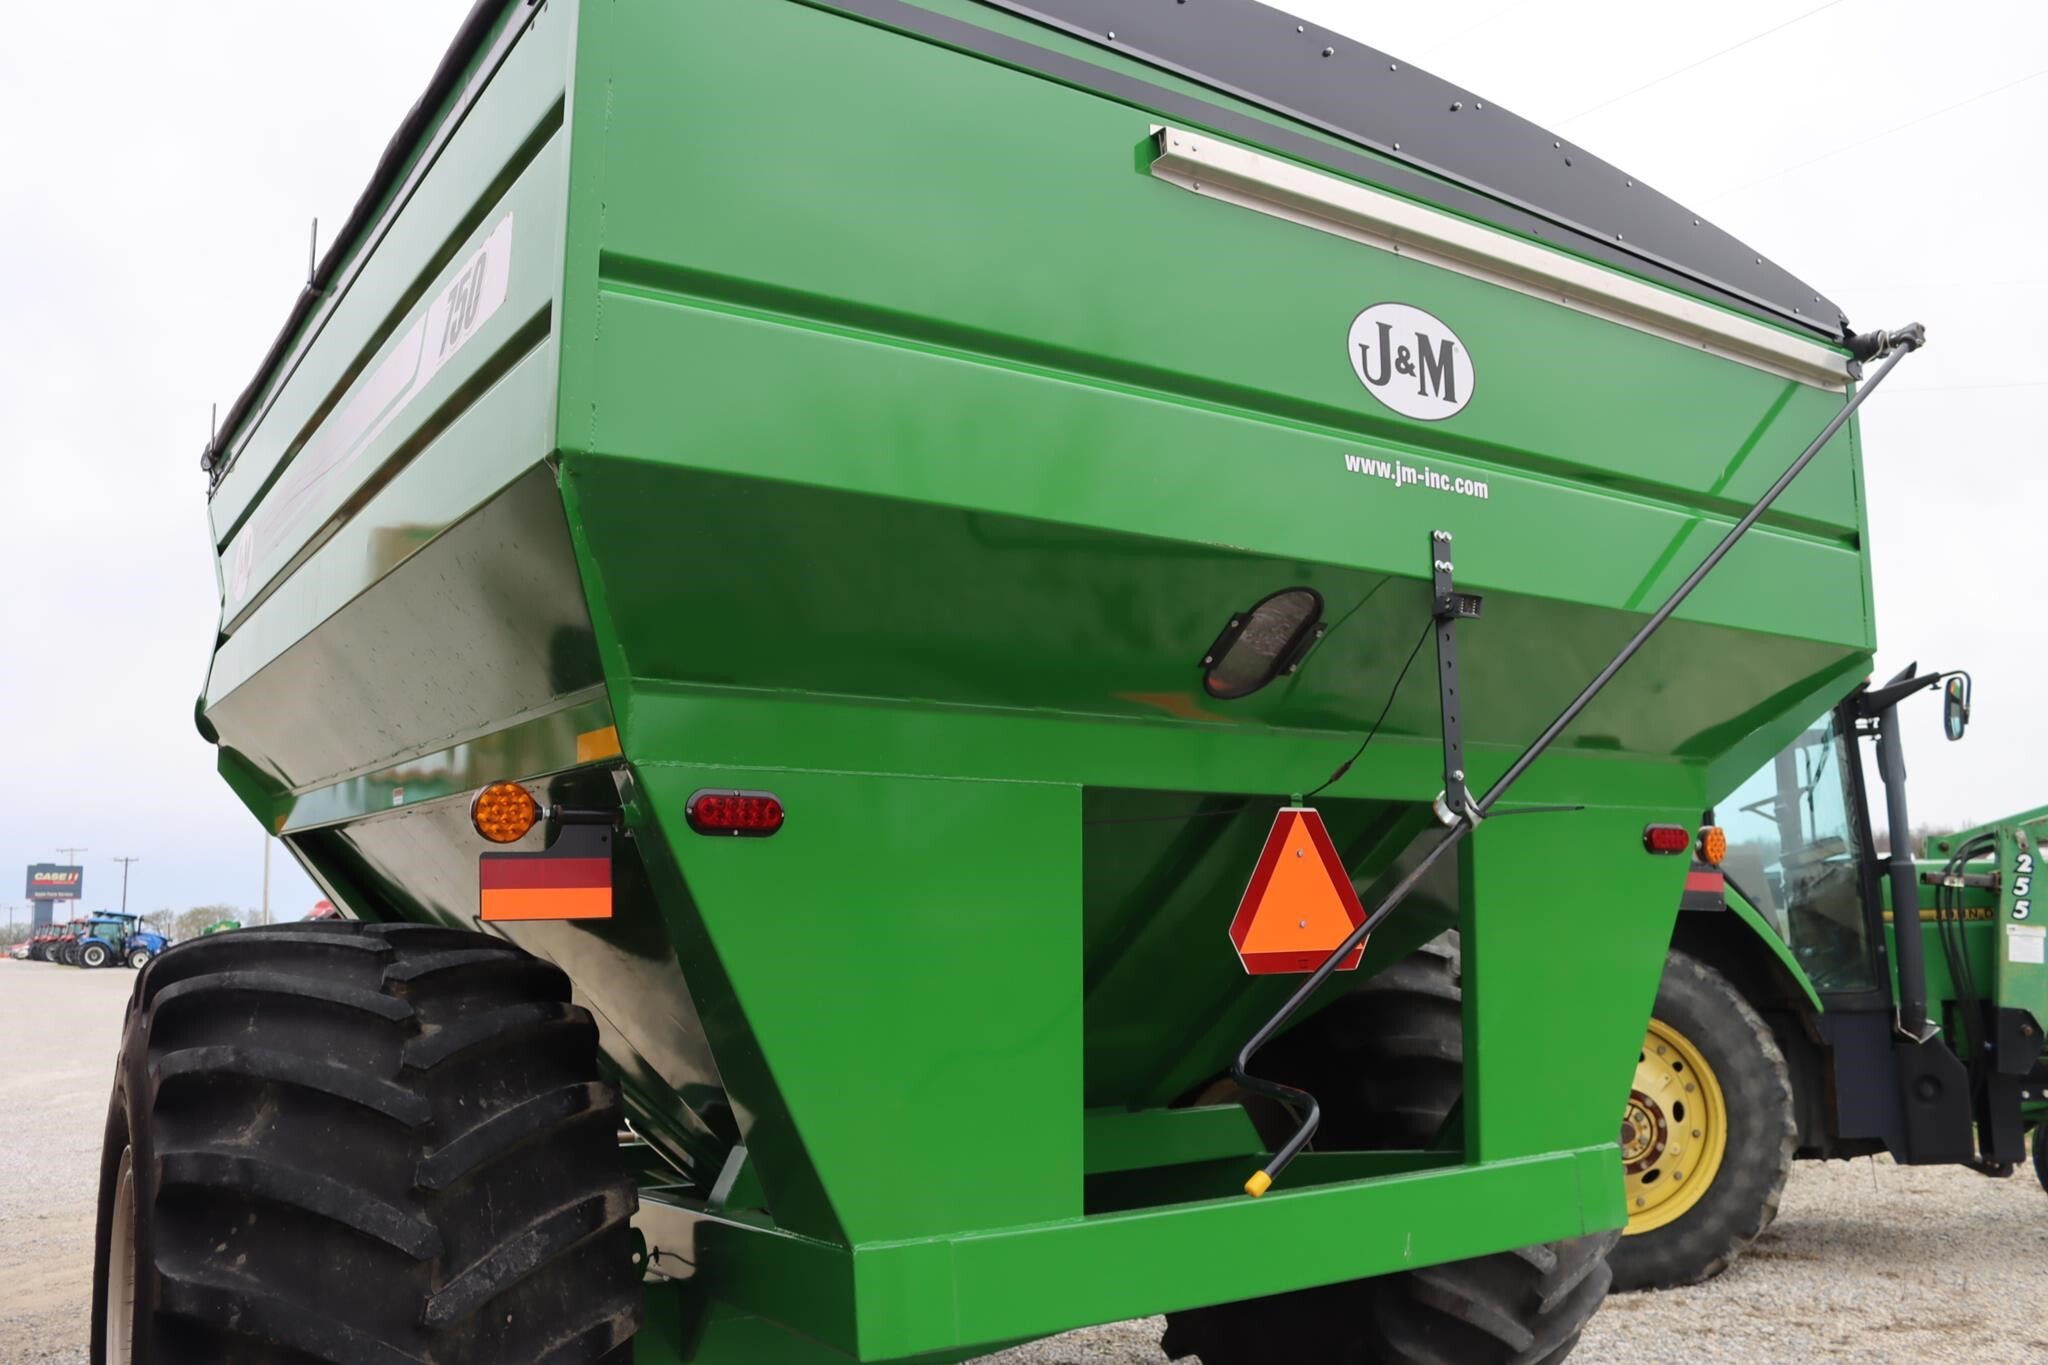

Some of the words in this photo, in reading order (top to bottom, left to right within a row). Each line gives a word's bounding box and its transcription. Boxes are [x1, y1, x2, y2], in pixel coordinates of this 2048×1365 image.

[439, 252, 487, 358] 750
[1358, 321, 1457, 404] J&M
[1345, 454, 1488, 499] www.jm-inc.com
[34, 872, 67, 881] CASE
